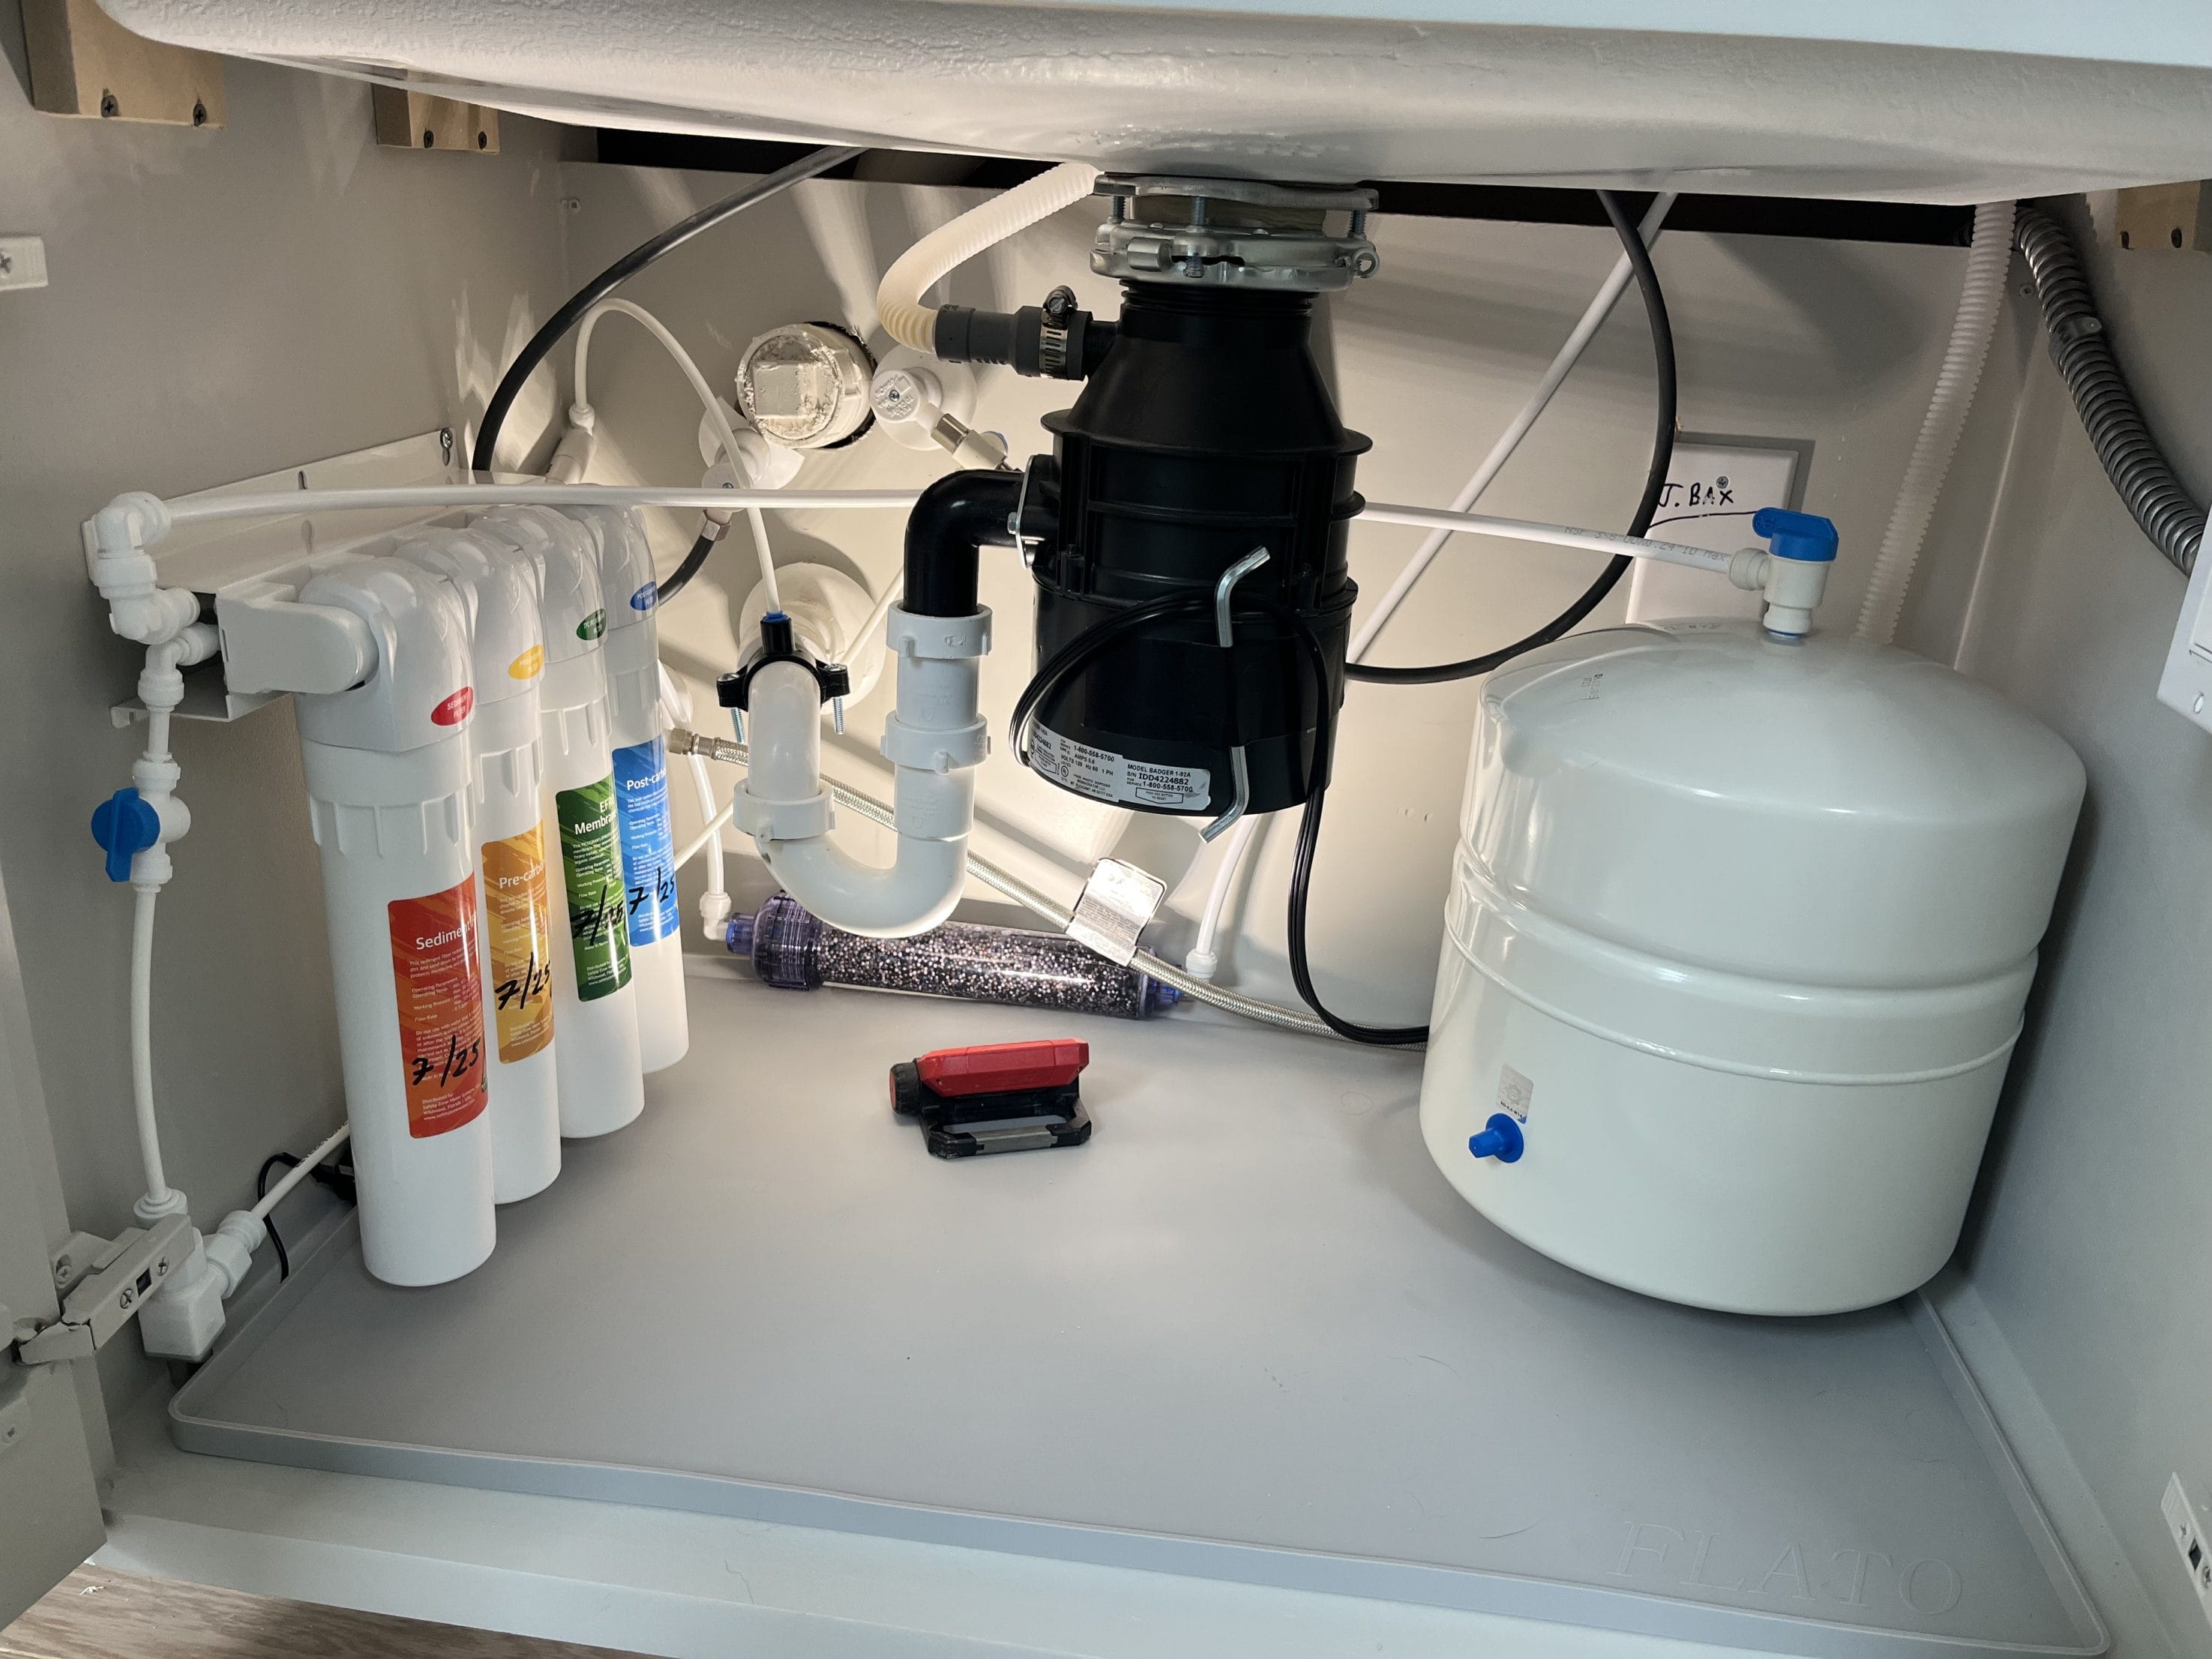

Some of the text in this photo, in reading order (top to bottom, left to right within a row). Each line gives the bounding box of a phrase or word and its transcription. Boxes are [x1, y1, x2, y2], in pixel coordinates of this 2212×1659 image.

[1060, 753, 1075, 764] VOLTS
[1074, 744, 1115, 762] 1-800-558-5700
[1127, 763, 1147, 772] MODEL
[1149, 768, 1174, 776] BADGER
[1138, 772, 1189, 786] IDD4224882
[1142, 780, 1193, 792] 1-800-558-5700
[628, 866, 675, 915] 7/25
[494, 951, 551, 1011] 7/25
[412, 1035, 481, 1088] 7/25
